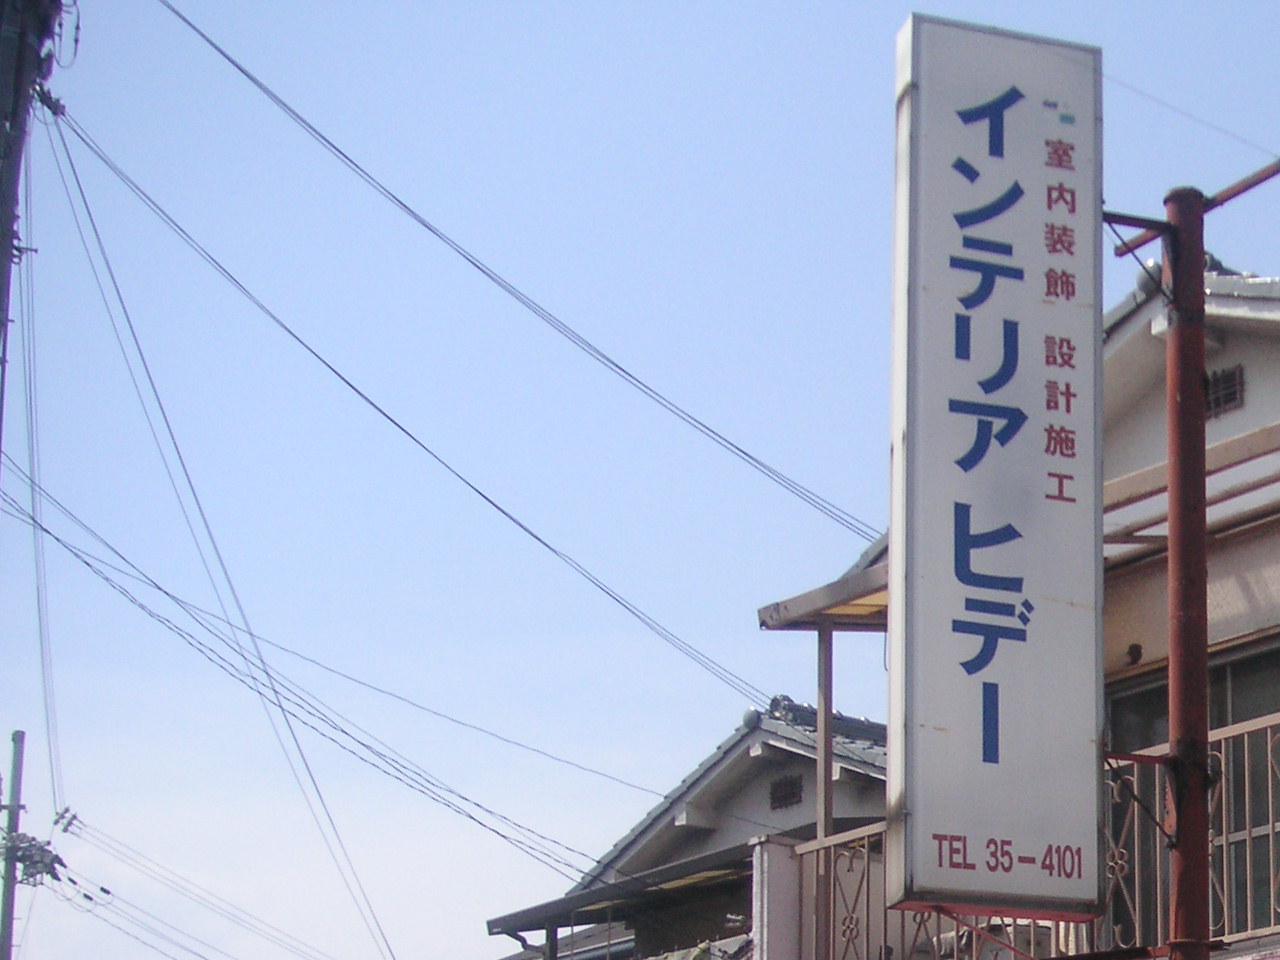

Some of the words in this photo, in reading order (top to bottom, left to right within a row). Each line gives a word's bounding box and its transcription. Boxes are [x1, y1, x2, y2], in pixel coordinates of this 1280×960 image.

[948, 85, 1029, 474] インテリア
[1043, 138, 1077, 302] 室内装飾
[1043, 335, 1077, 503] 設計施工
[951, 501, 1035, 765] ヒデー
[932, 833, 977, 871] TEL
[985, 837, 1083, 880] 35-4101
